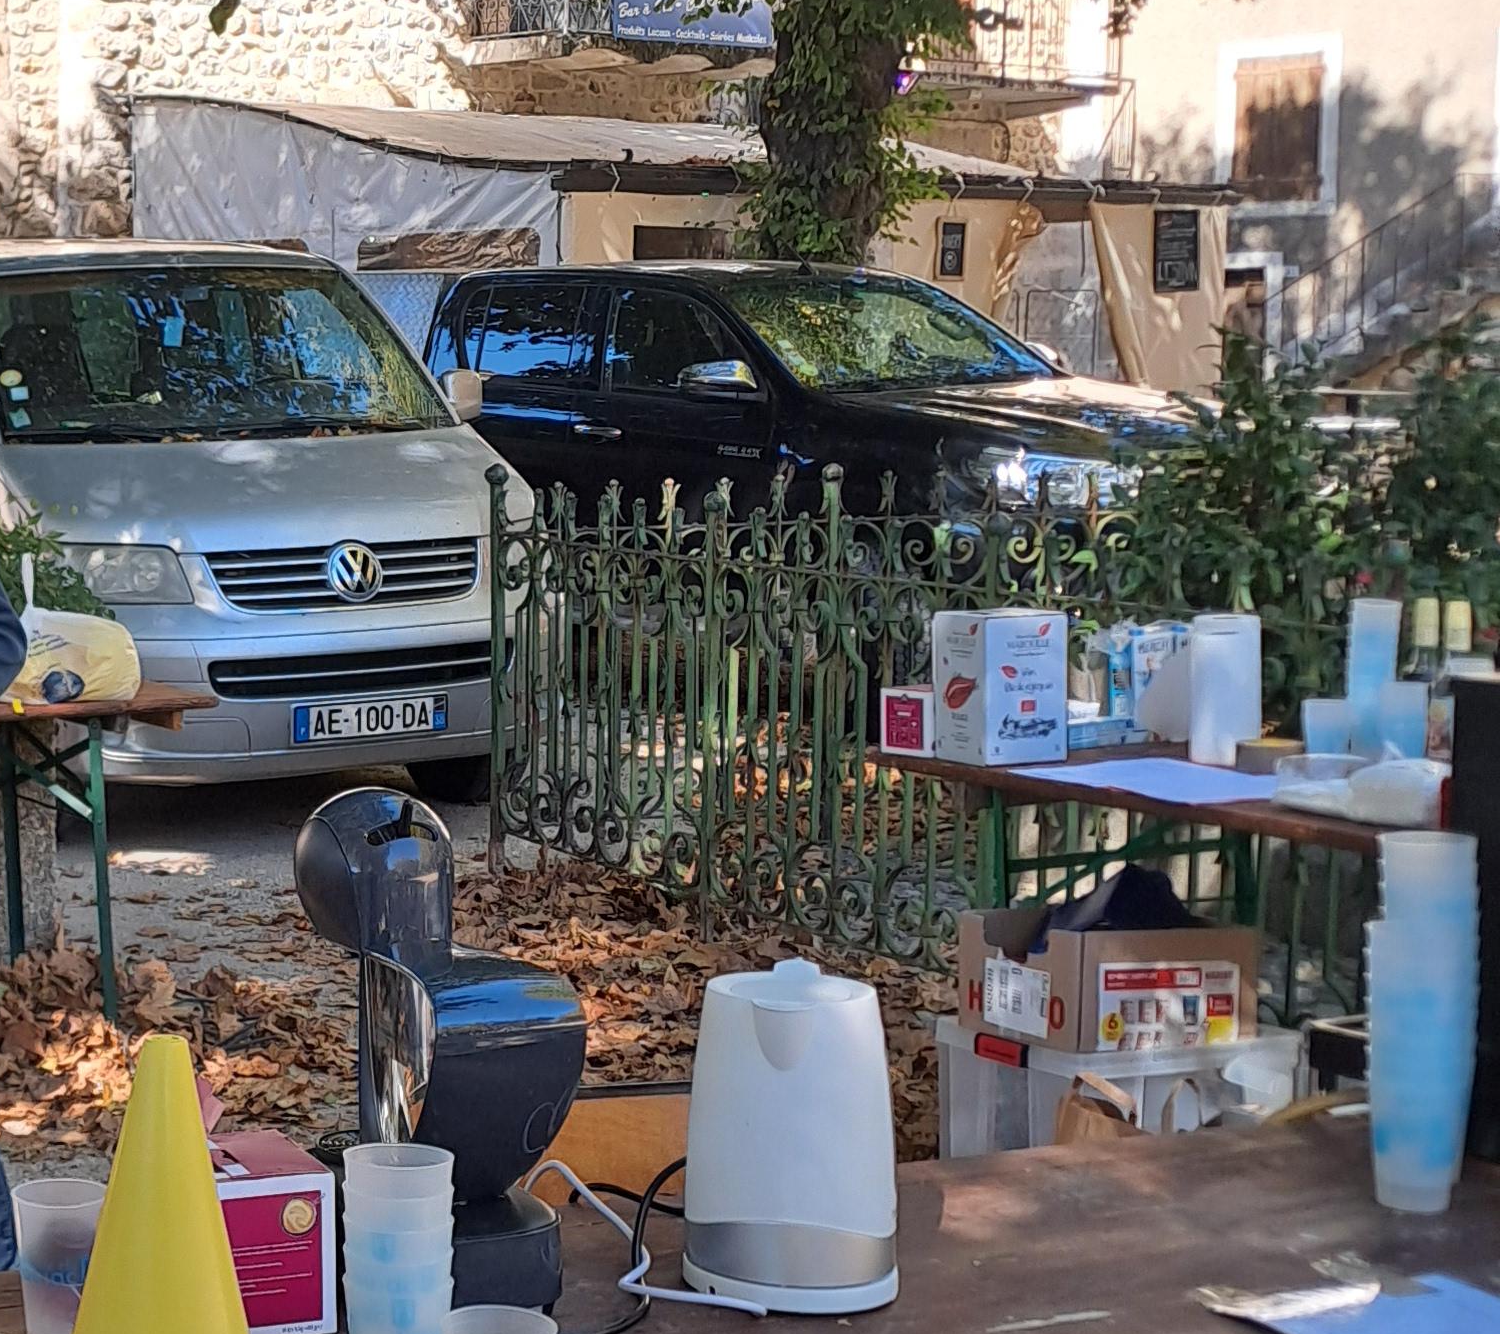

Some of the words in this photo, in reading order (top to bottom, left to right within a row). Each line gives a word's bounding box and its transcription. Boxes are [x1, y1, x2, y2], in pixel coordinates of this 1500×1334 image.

[618, 1, 641, 18] Bar
[617, 23, 646, 37] Produits
[675, 28, 706, 40] Cocktails
[313, 701, 430, 737] AE-100-DA
